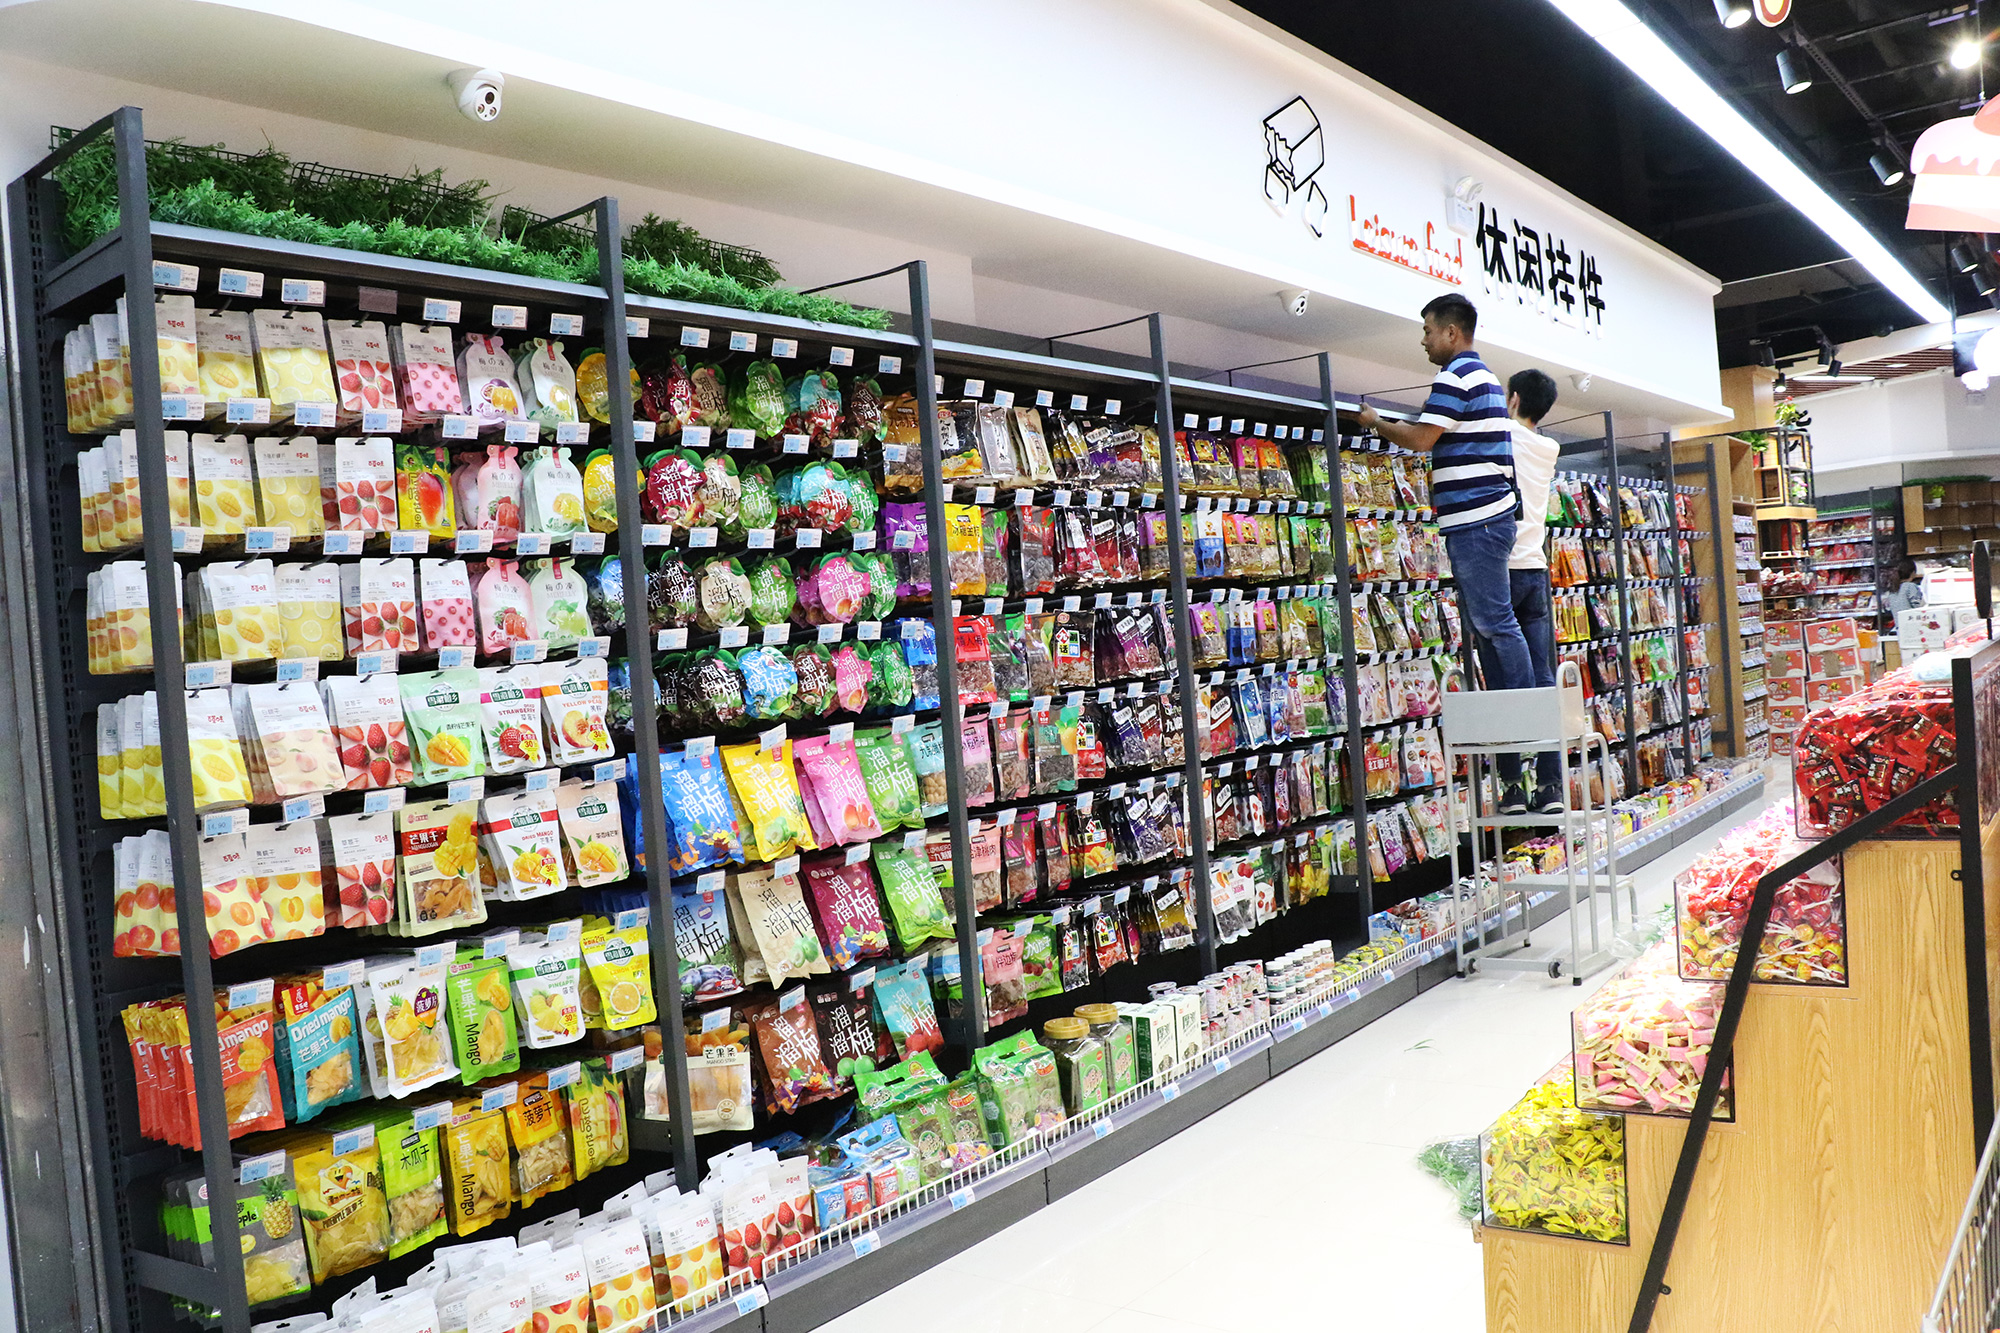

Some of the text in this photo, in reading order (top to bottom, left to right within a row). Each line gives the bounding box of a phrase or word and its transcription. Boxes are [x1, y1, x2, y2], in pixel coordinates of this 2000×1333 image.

[1476, 201, 1606, 338] 休闲挂件
[562, 700, 586, 708] YELLOW
[409, 833, 439, 844] 芒果干
[536, 830, 554, 838] MANGO
[457, 978, 478, 1023] 芒果干
[224, 1018, 269, 1048] mango
[291, 996, 352, 1043] Dried mango
[297, 1035, 330, 1062] 芒果干
[464, 1022, 482, 1066] Mango
[522, 1102, 553, 1127] 菠萝干
[400, 1144, 430, 1171] 木瓜干
[456, 1130, 475, 1172] 芒果干
[461, 1174, 475, 1216] Mango
